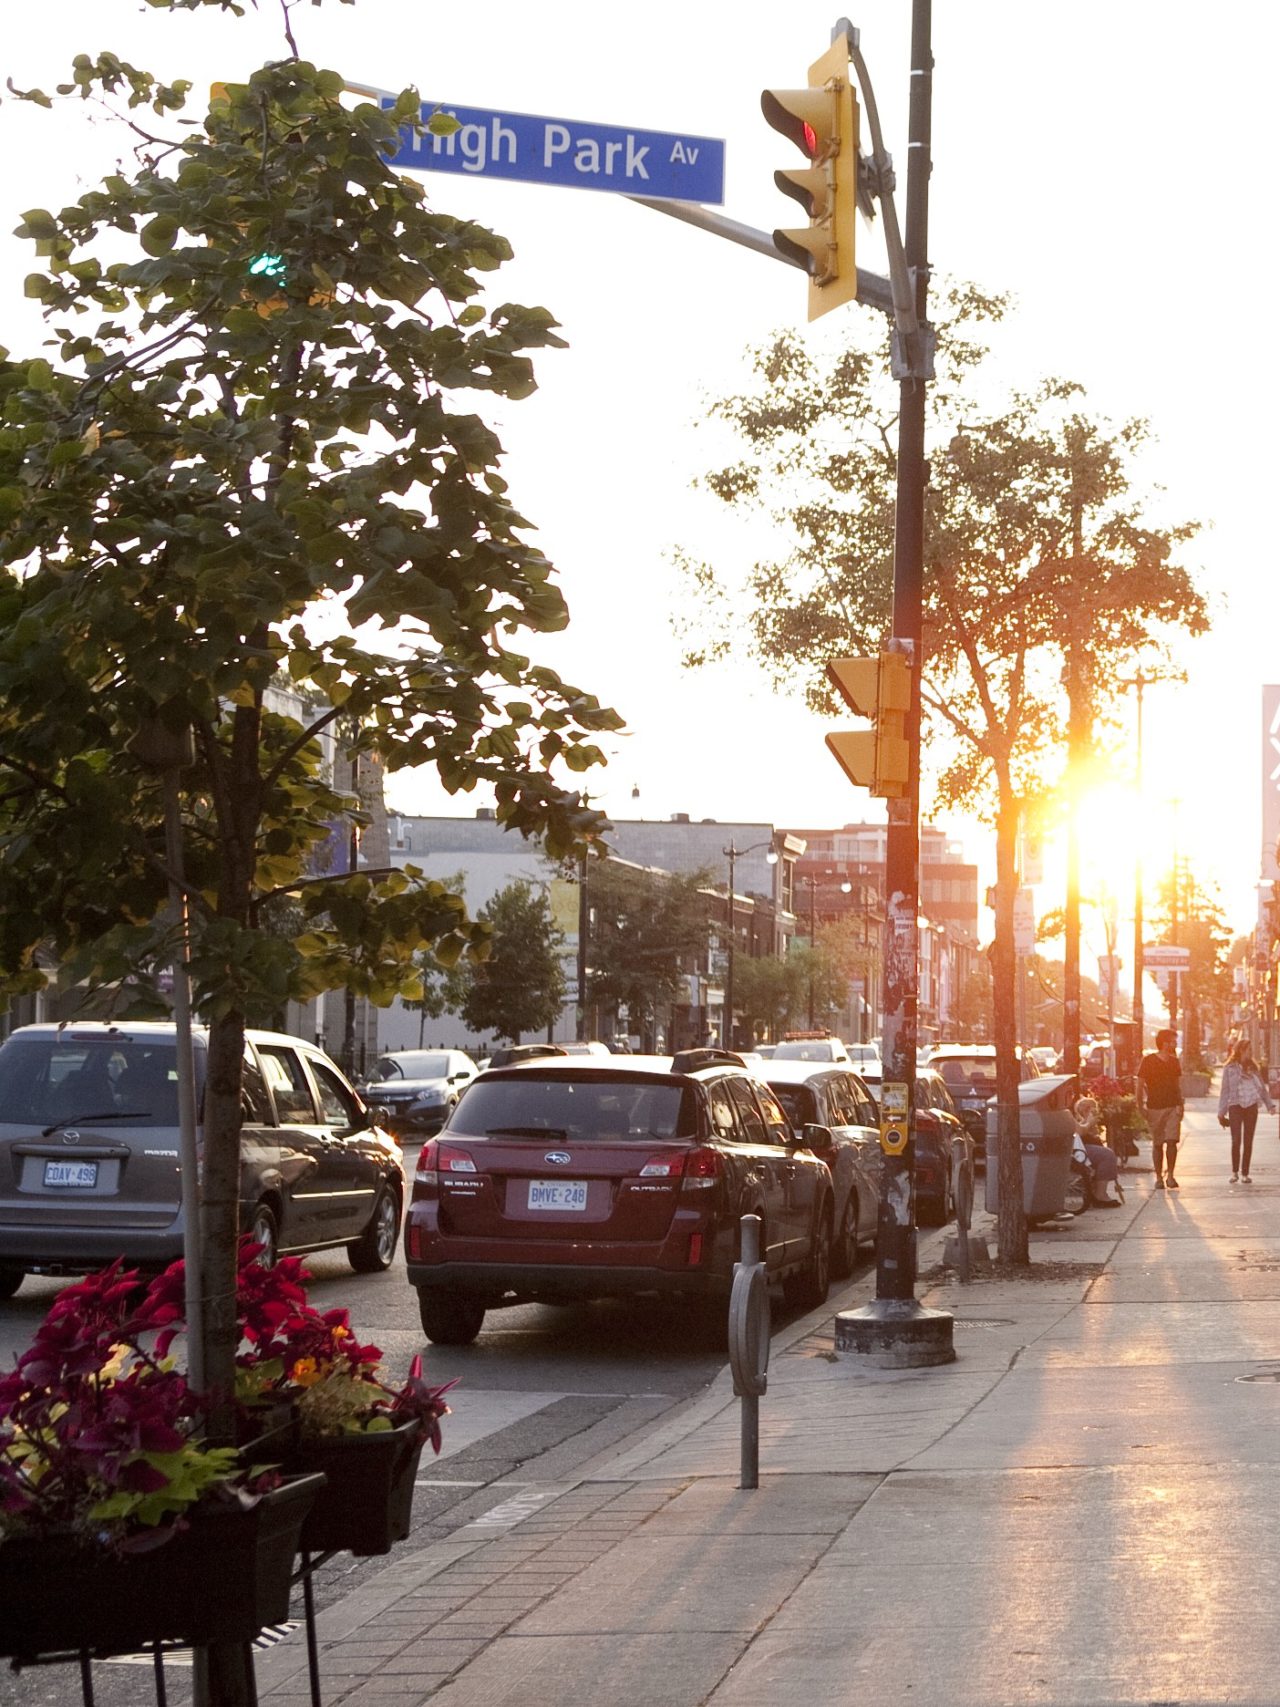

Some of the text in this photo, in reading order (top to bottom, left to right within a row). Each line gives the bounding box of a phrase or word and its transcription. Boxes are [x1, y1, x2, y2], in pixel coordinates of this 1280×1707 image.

[543, 124, 650, 180] Park
[669, 141, 699, 165] Av
[531, 1187, 585, 1204] BMVE 248
